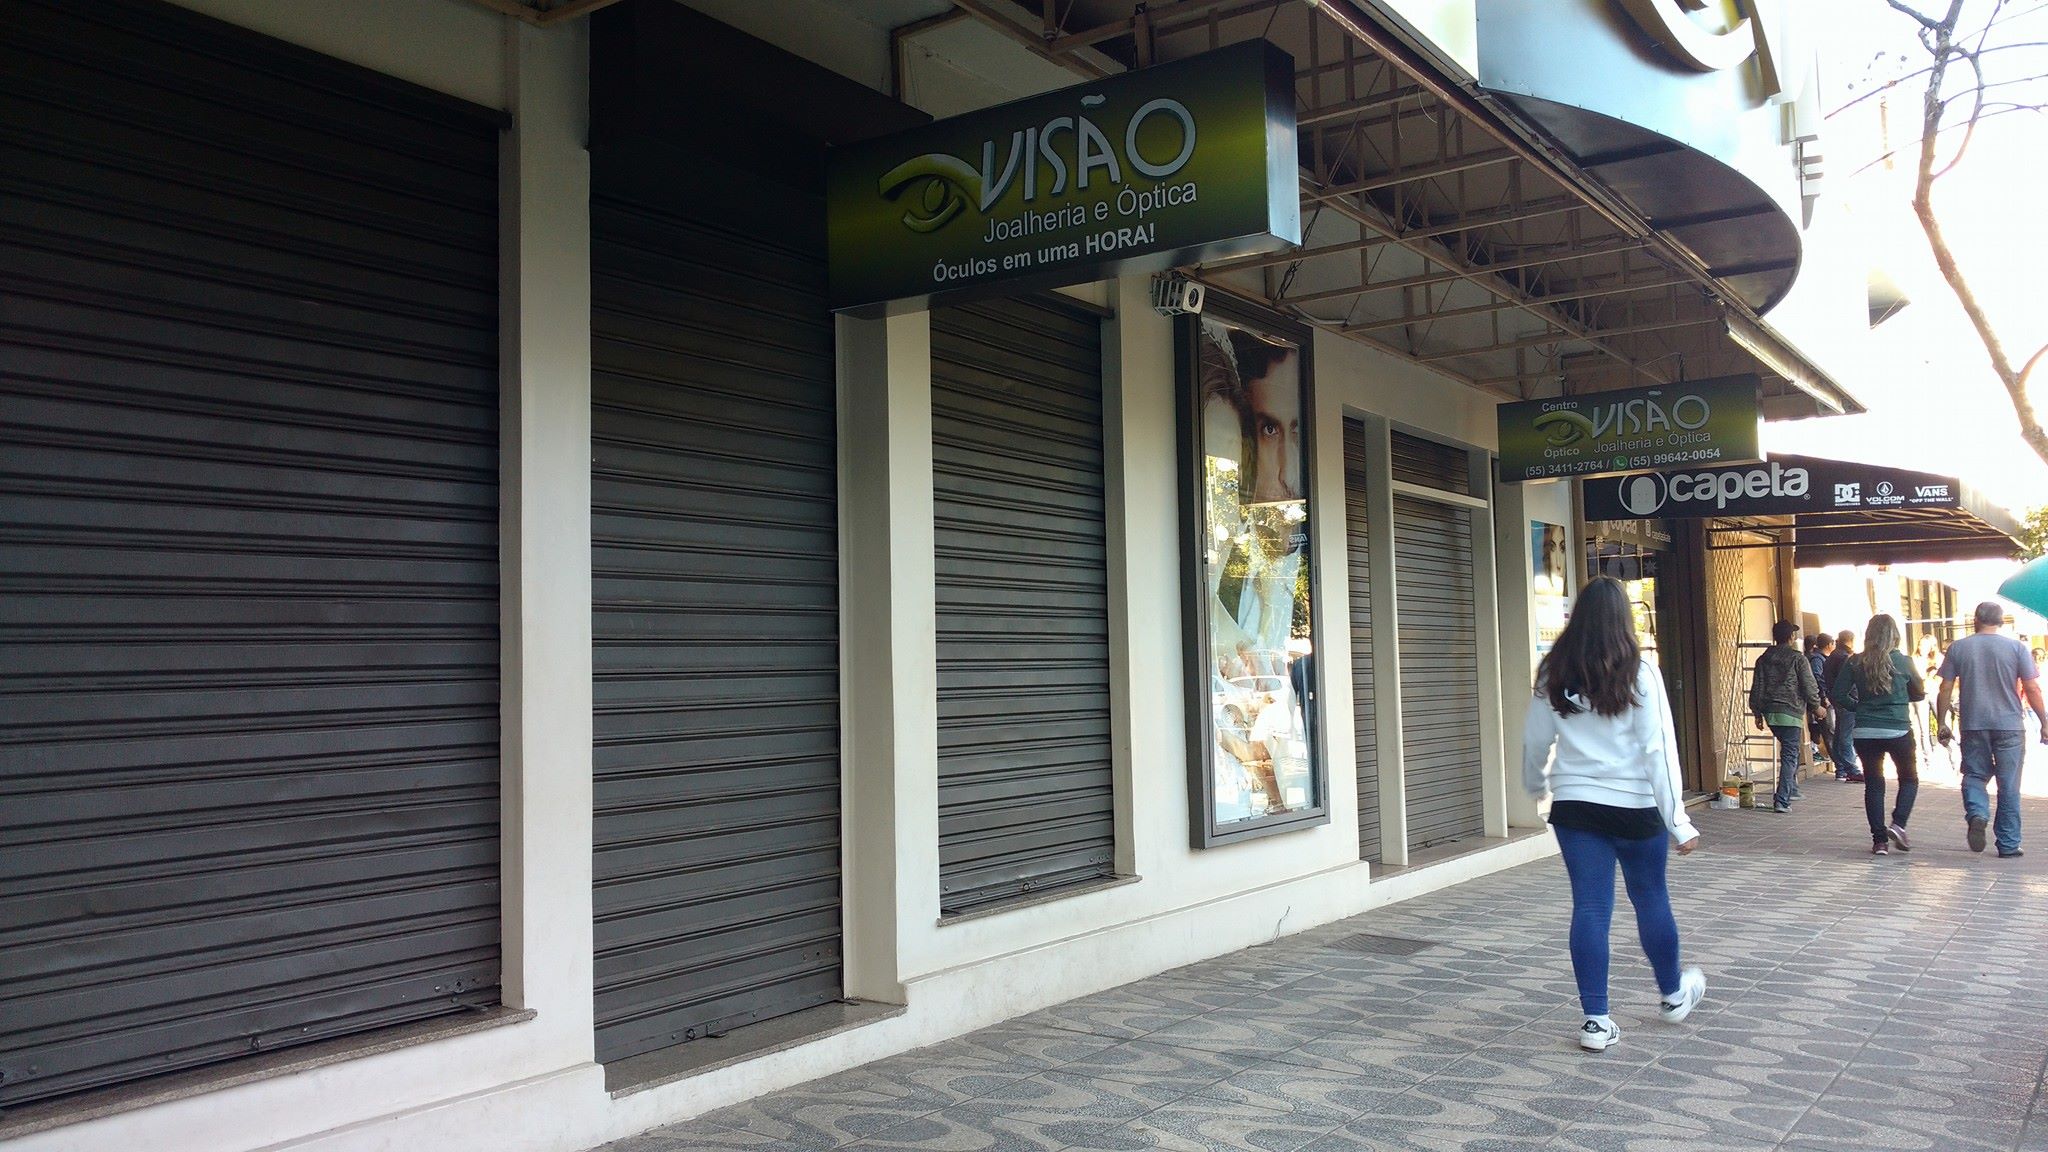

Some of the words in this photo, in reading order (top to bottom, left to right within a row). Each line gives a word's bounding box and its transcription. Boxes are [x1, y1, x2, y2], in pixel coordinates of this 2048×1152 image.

[981, 94, 1197, 213] VISÃO
[984, 203, 1086, 243] Joalheria
[1094, 201, 1109, 221] e
[1117, 182, 1197, 219] Óptica
[933, 257, 998, 282] Óculos
[1003, 252, 1031, 270] em
[1037, 242, 1080, 264] uma
[1085, 223, 1155, 255] HORA!
[1542, 401, 1578, 412] Centro
[1592, 390, 1711, 438] VISÃO
[1544, 446, 1580, 460] Óptico
[1594, 438, 1651, 453] Joalheria
[1656, 438, 1664, 446] e
[1668, 431, 1711, 448] Óptica
[1525, 465, 1546, 477] (55)
[1549, 460, 1603, 474] 3411-2764
[1629, 456, 1650, 468] (55)
[1653, 448, 1721, 464] 99642-0054
[1669, 462, 1809, 509] capeta
[1914, 485, 1949, 497] VANS
